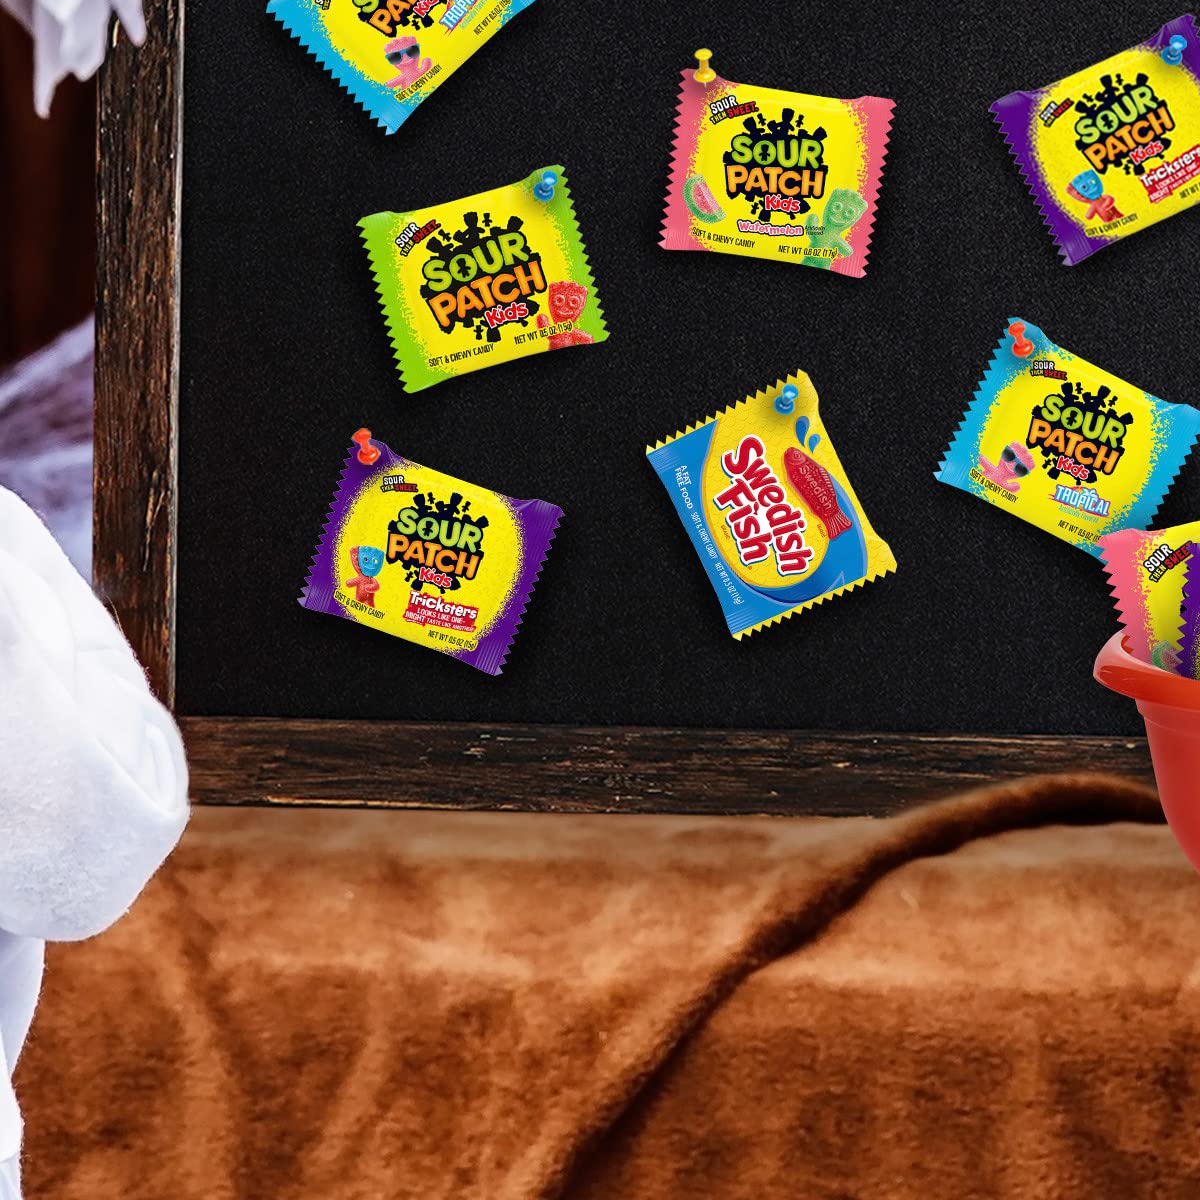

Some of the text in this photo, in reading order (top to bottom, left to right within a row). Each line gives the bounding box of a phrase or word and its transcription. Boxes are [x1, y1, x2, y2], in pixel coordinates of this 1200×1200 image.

[710, 95, 738, 114] SOUR
[727, 102, 759, 118] SWEET.
[1076, 86, 1158, 144] SOUR
[732, 135, 822, 169] SOUR
[1084, 107, 1175, 171] PATCH
[1130, 141, 1164, 165] Kids
[726, 165, 824, 197] PATCH
[764, 194, 801, 212] Kids
[395, 223, 420, 248] SOUR
[692, 227, 706, 239] SOFT
[712, 233, 734, 245] CHEWY
[735, 237, 756, 248] CANDY
[737, 220, 804, 237] Watermelon
[424, 232, 529, 291] SOUR
[778, 245, 790, 253] NET
[791, 246, 802, 255] WT
[812, 248, 822, 256] OZ
[429, 261, 545, 327] PATCH
[484, 302, 529, 329] Kids
[514, 335, 526, 345] NET
[527, 331, 539, 341] WT
[428, 343, 494, 367] SOFT & CHEWY CANDY
[1034, 361, 1055, 370] SOUR
[1041, 395, 1126, 448] SOUR
[1029, 418, 1120, 474] PATCH
[383, 475, 404, 486] SOUR
[682, 471, 692, 485] FAT
[1056, 455, 1090, 480] Kids
[675, 467, 694, 509] FREE FOOD
[799, 464, 832, 510] Swedish
[1055, 484, 1111, 516] TROPICAL
[724, 436, 813, 574] Swedish
[397, 509, 482, 552] SOUR
[715, 480, 772, 563] Fish
[389, 533, 480, 580] PATCH
[1144, 544, 1173, 572] SOUR
[1150, 541, 1192, 582] THEN SWEE
[418, 567, 452, 588] Kids
[410, 591, 478, 619] Tricksters
[417, 607, 437, 618] LOOKS
